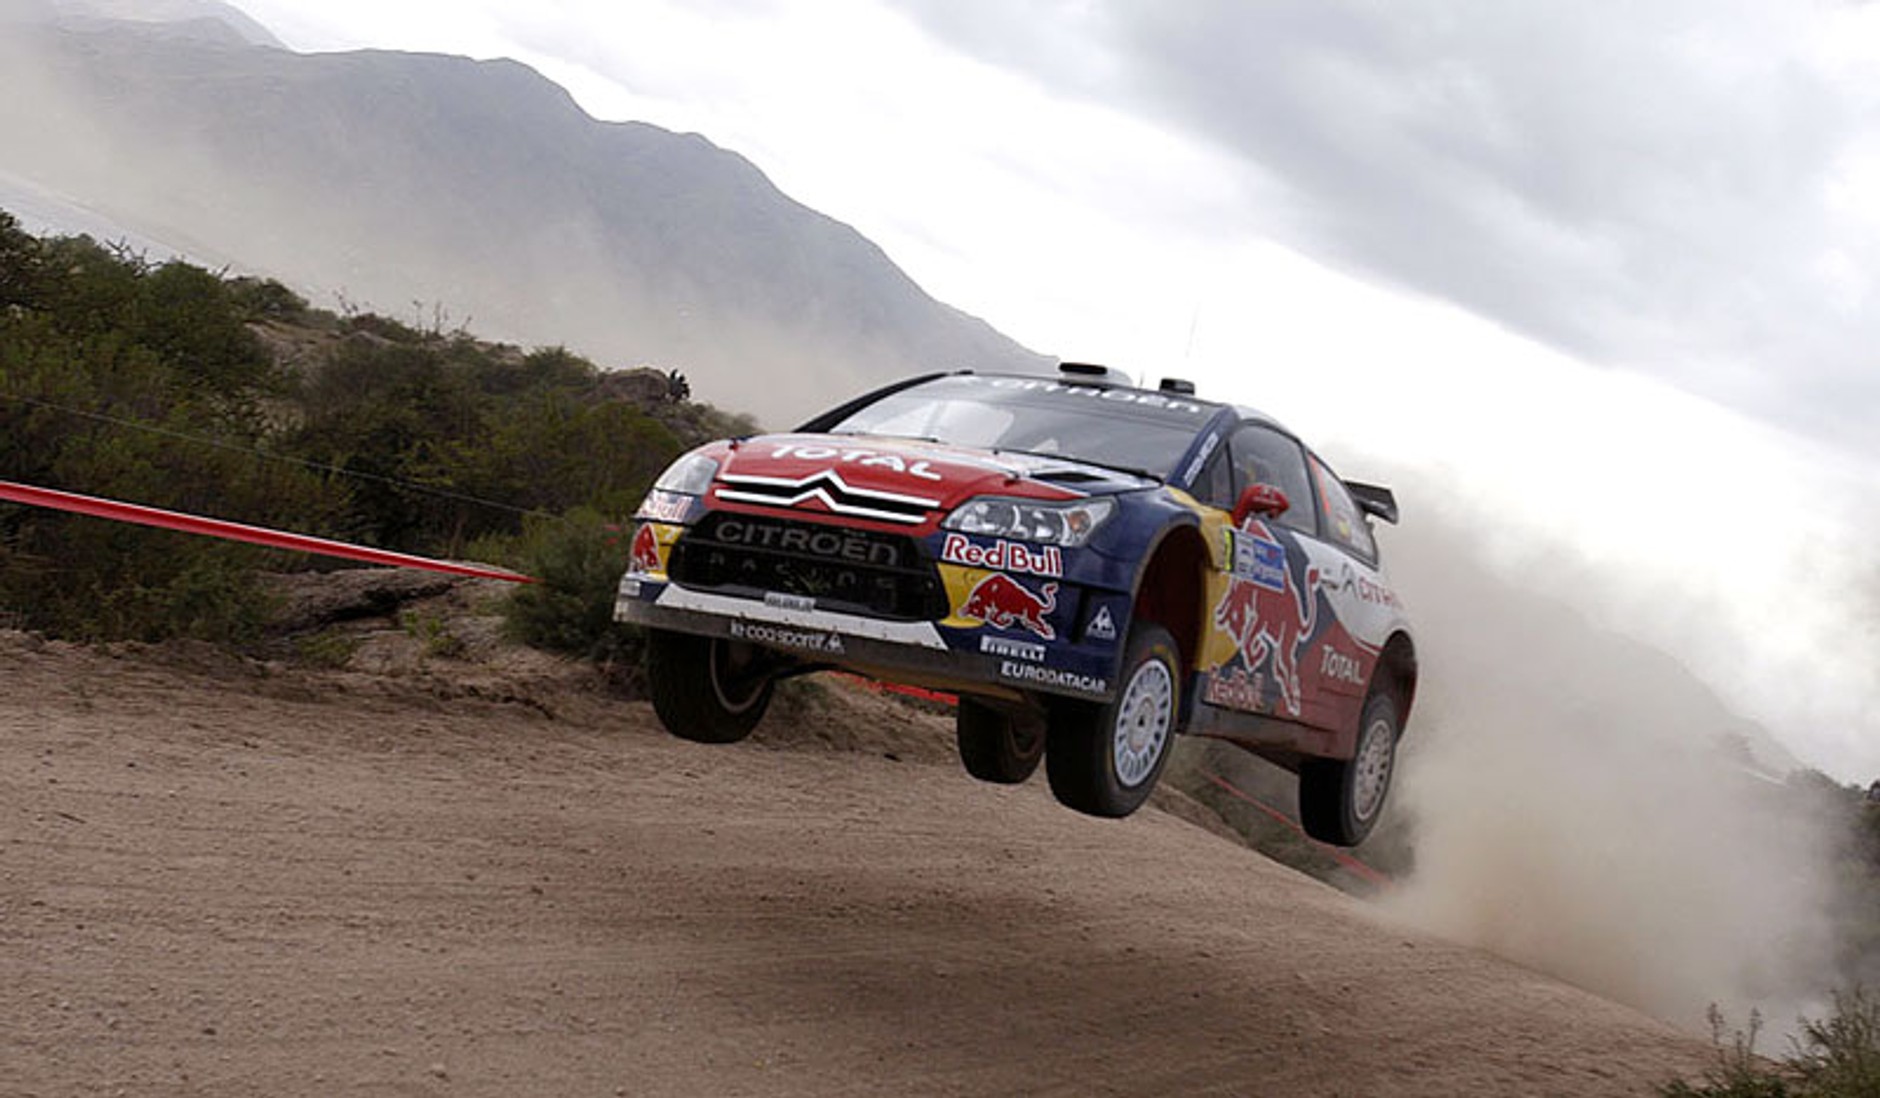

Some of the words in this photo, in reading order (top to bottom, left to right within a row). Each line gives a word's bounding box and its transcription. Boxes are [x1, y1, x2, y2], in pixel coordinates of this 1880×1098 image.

[771, 445, 942, 481] TOTAL
[942, 533, 1007, 570] Red
[1008, 542, 1064, 577] Bull
[1001, 660, 1106, 693] EURODATACAR
[1321, 643, 1364, 686] TOTAL
